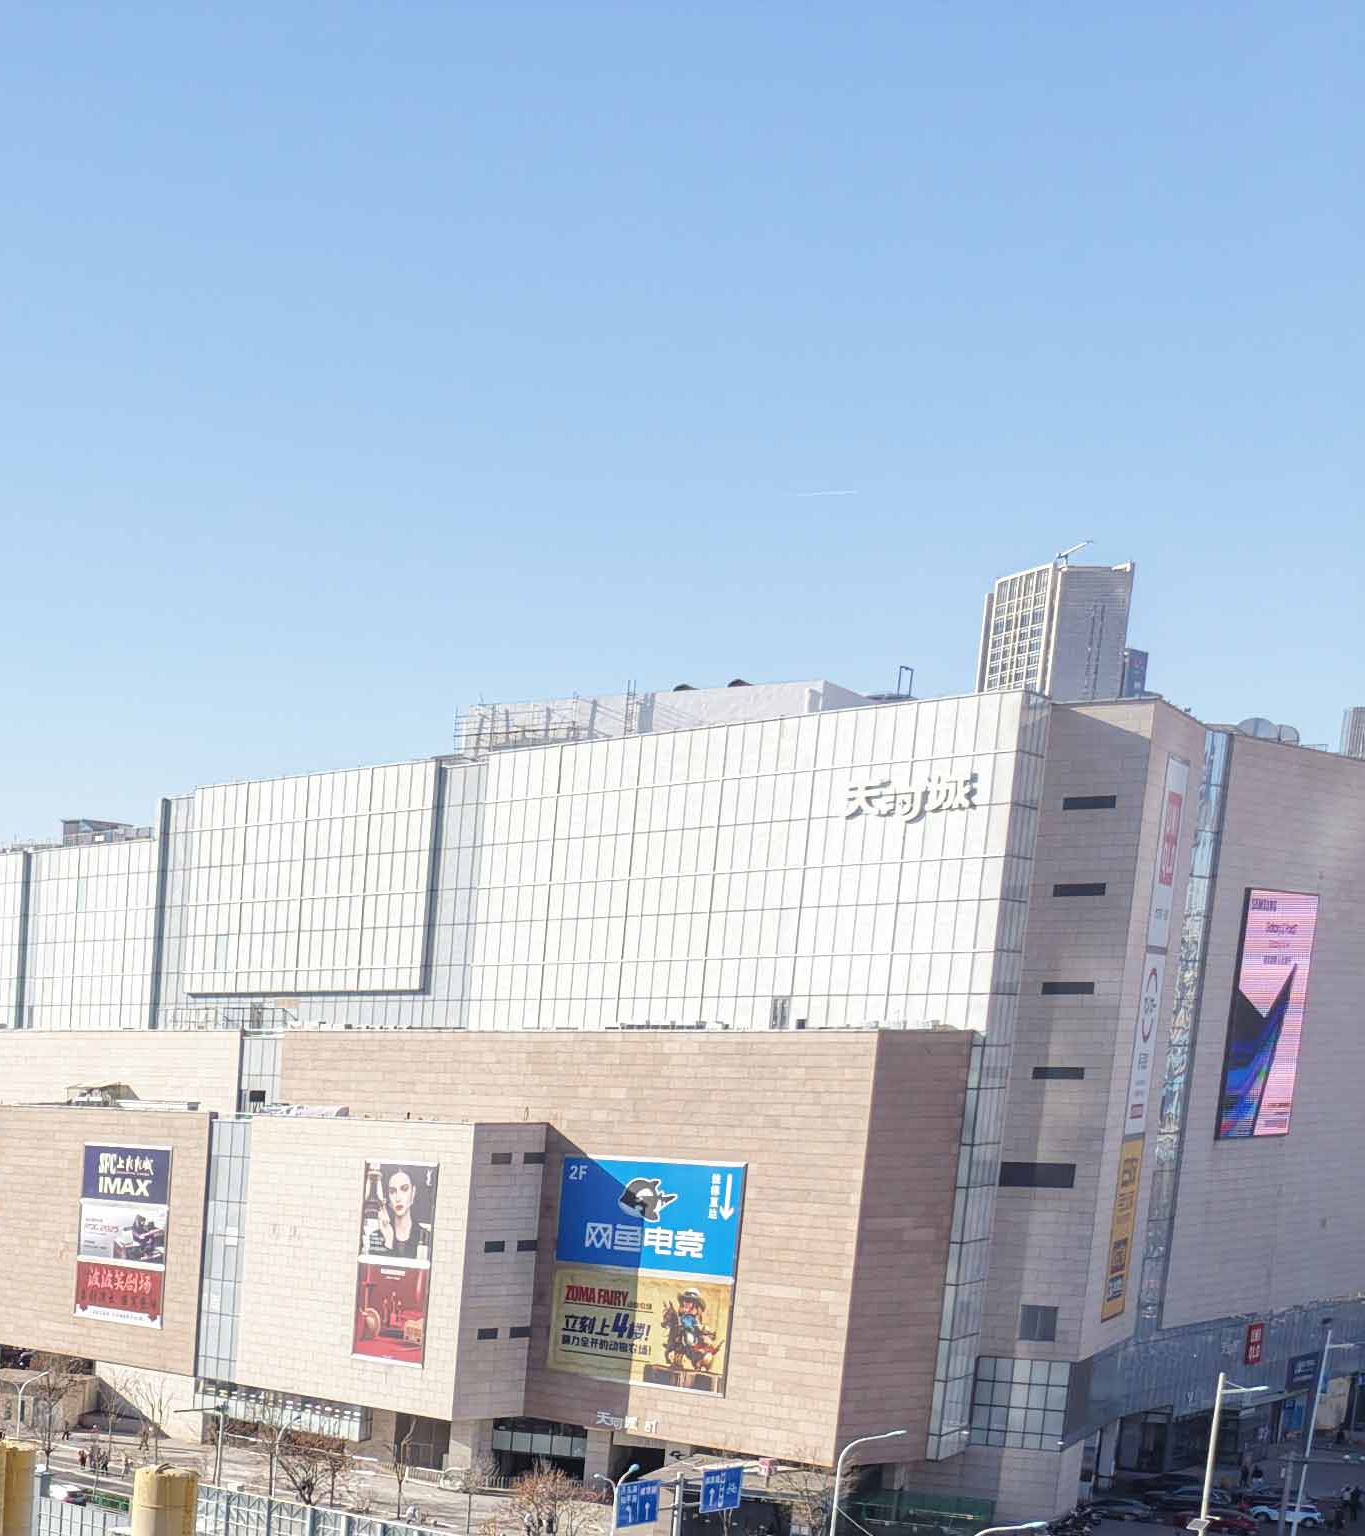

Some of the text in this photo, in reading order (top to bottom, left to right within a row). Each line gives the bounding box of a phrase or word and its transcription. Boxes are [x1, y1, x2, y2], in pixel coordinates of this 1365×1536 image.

[568, 1164, 589, 1181] 2F
[98, 1175, 153, 1198] IMAX
[584, 1221, 706, 1260] 网鱼电竞
